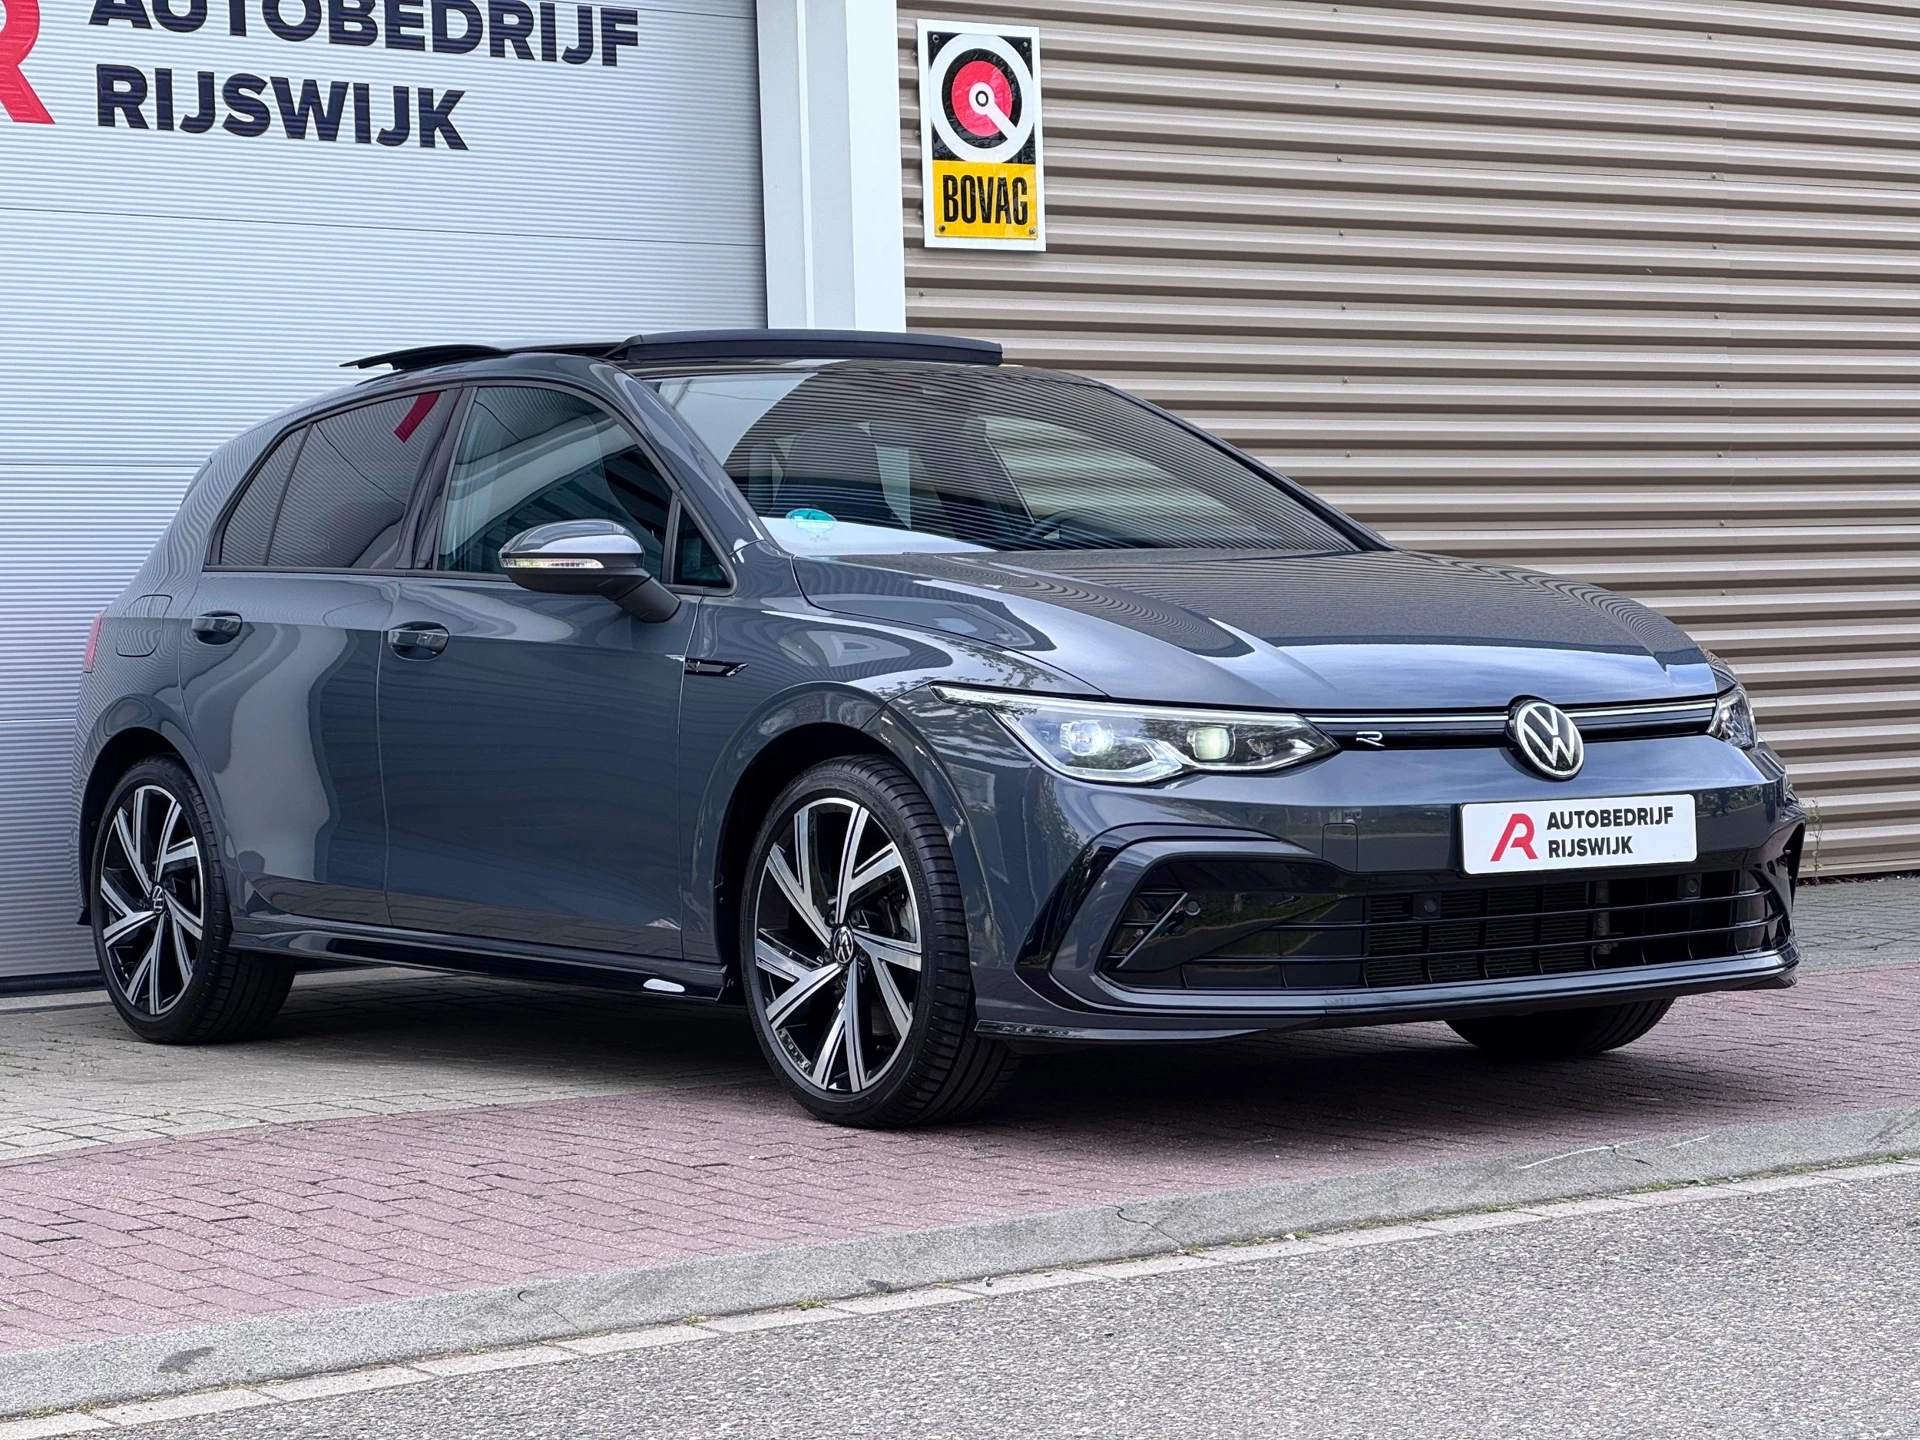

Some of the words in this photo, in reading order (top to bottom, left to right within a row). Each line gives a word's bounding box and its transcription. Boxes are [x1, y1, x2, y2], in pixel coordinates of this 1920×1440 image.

[96, 63, 469, 151] RIJSWIJK
[942, 174, 1028, 226] BOVAG
[1547, 806, 1674, 830] AUTOBEDRIJF
[1548, 836, 1633, 858] RIJSWIJK
